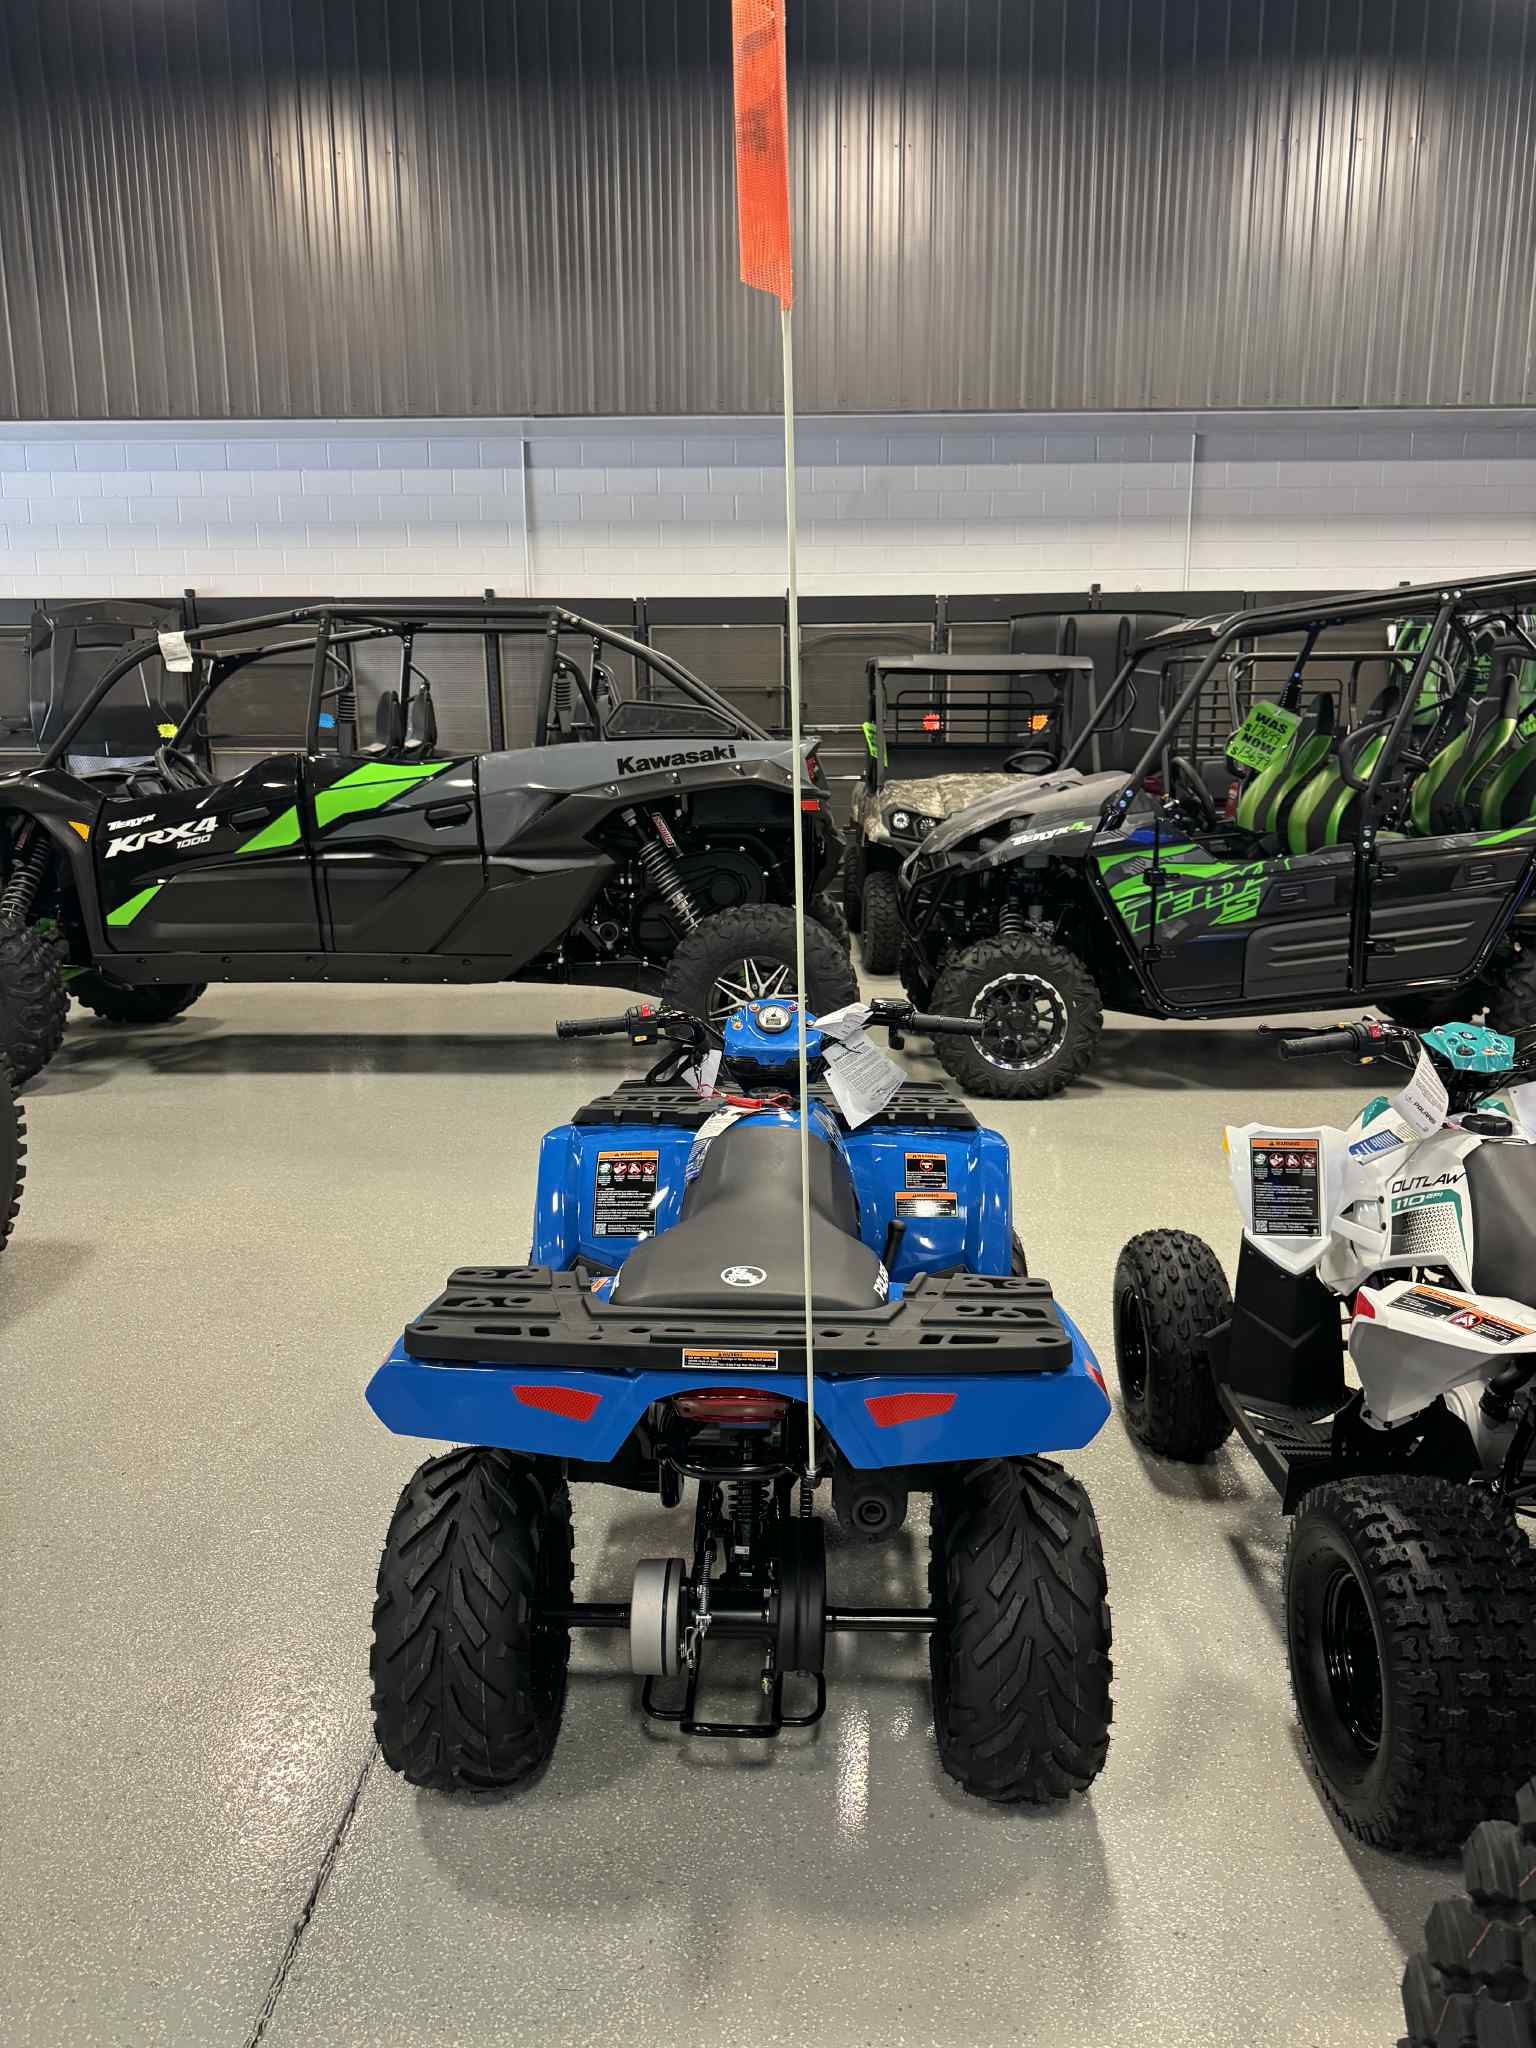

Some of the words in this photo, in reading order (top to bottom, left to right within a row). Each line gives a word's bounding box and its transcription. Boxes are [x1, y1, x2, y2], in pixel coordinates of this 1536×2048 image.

[1256, 712, 1288, 734] WAS
[1242, 733, 1277, 755] NOW
[617, 744, 737, 775] Kawasaki
[104, 816, 219, 858] KRX4
[176, 834, 212, 849] 1000
[1391, 1172, 1469, 1194] OUTLAW
[1396, 1195, 1426, 1209] 110
